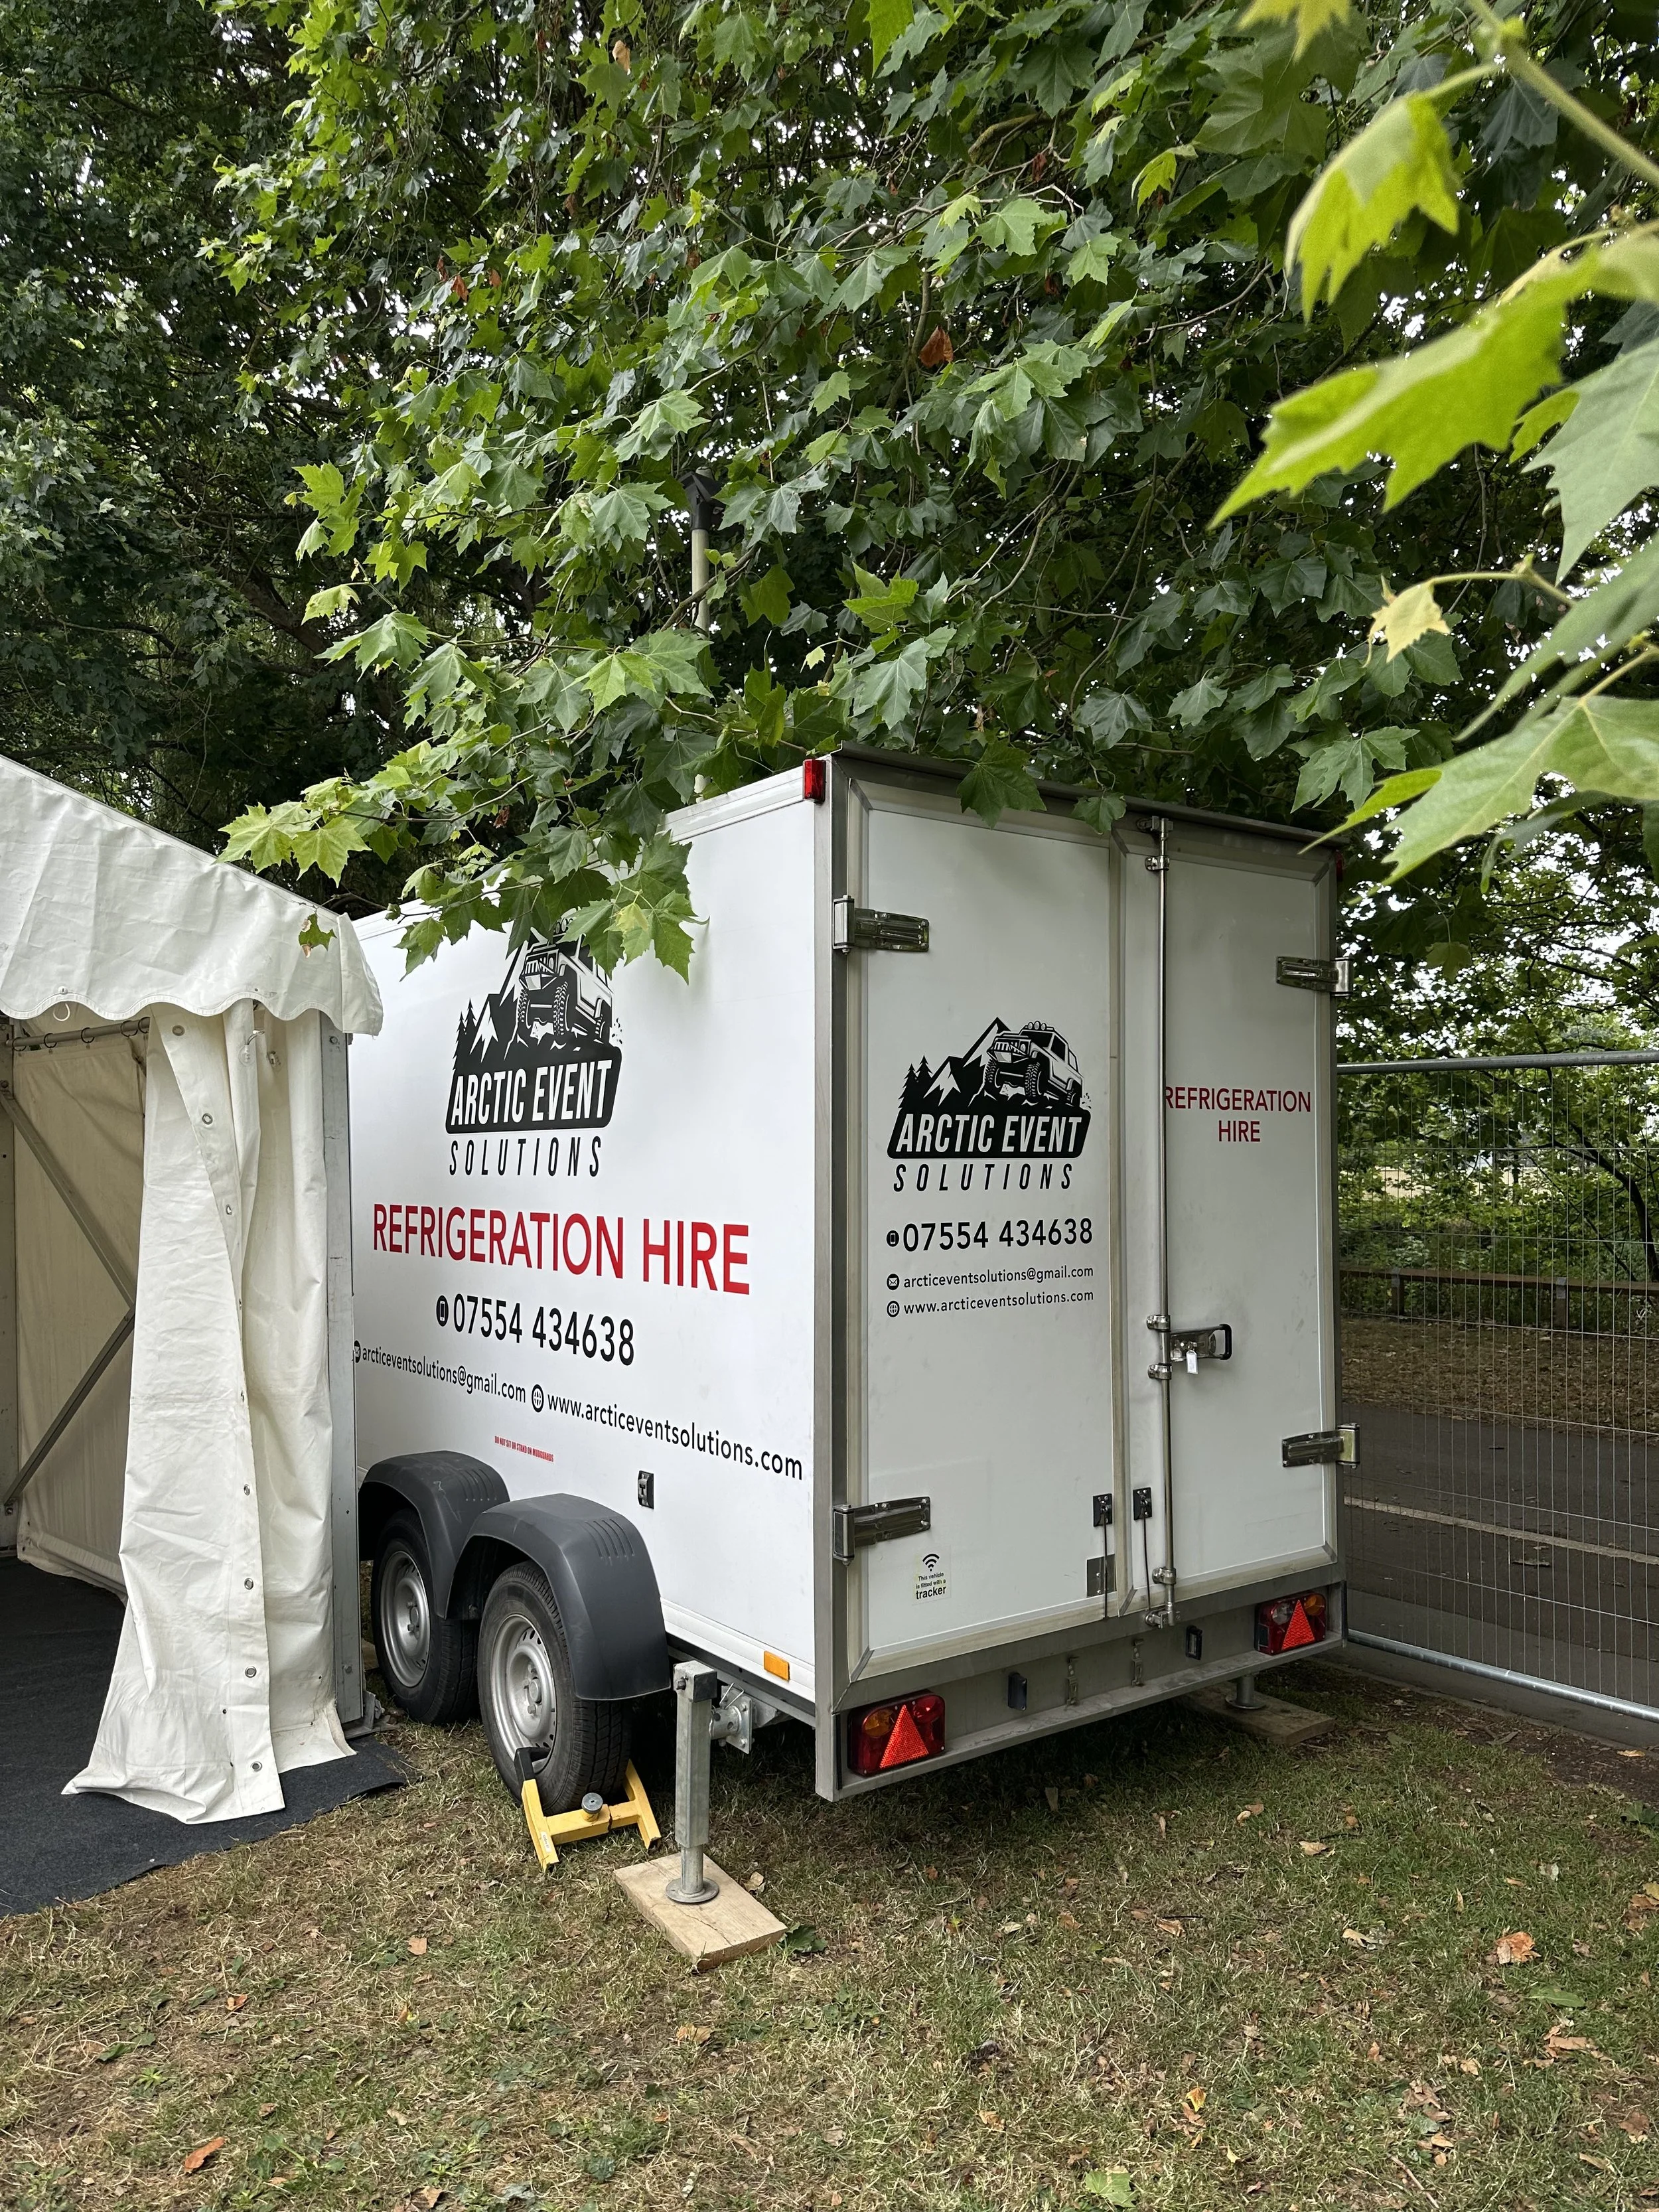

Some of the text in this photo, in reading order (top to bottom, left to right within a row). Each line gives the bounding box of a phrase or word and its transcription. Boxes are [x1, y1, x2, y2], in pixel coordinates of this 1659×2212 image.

[451, 1060, 612, 1126] ARCTIC EVENT
[1165, 1086, 1311, 1113] REFRIGERATION
[895, 1114, 1082, 1153] ARCTIC EVENT
[1218, 1120, 1261, 1143] HIRE
[449, 1136, 601, 1177] SOLUTIONS
[893, 1163, 1072, 1193] SOLUTIONS
[374, 1203, 750, 1295] REFRIGERATION HIRE
[902, 1217, 1093, 1252] 07554 434638
[903, 1265, 1094, 1288] arcticeventsolutions@gmail.com
[903, 1290, 1094, 1314] www.arcticeventsolutions.com
[453, 1293, 634, 1366] 07554 434638
[362, 1345, 802, 1481] arcticeventsolutions@gmail.com www.arcticeventsolutions.com
[916, 1586, 946, 1599] tracker
